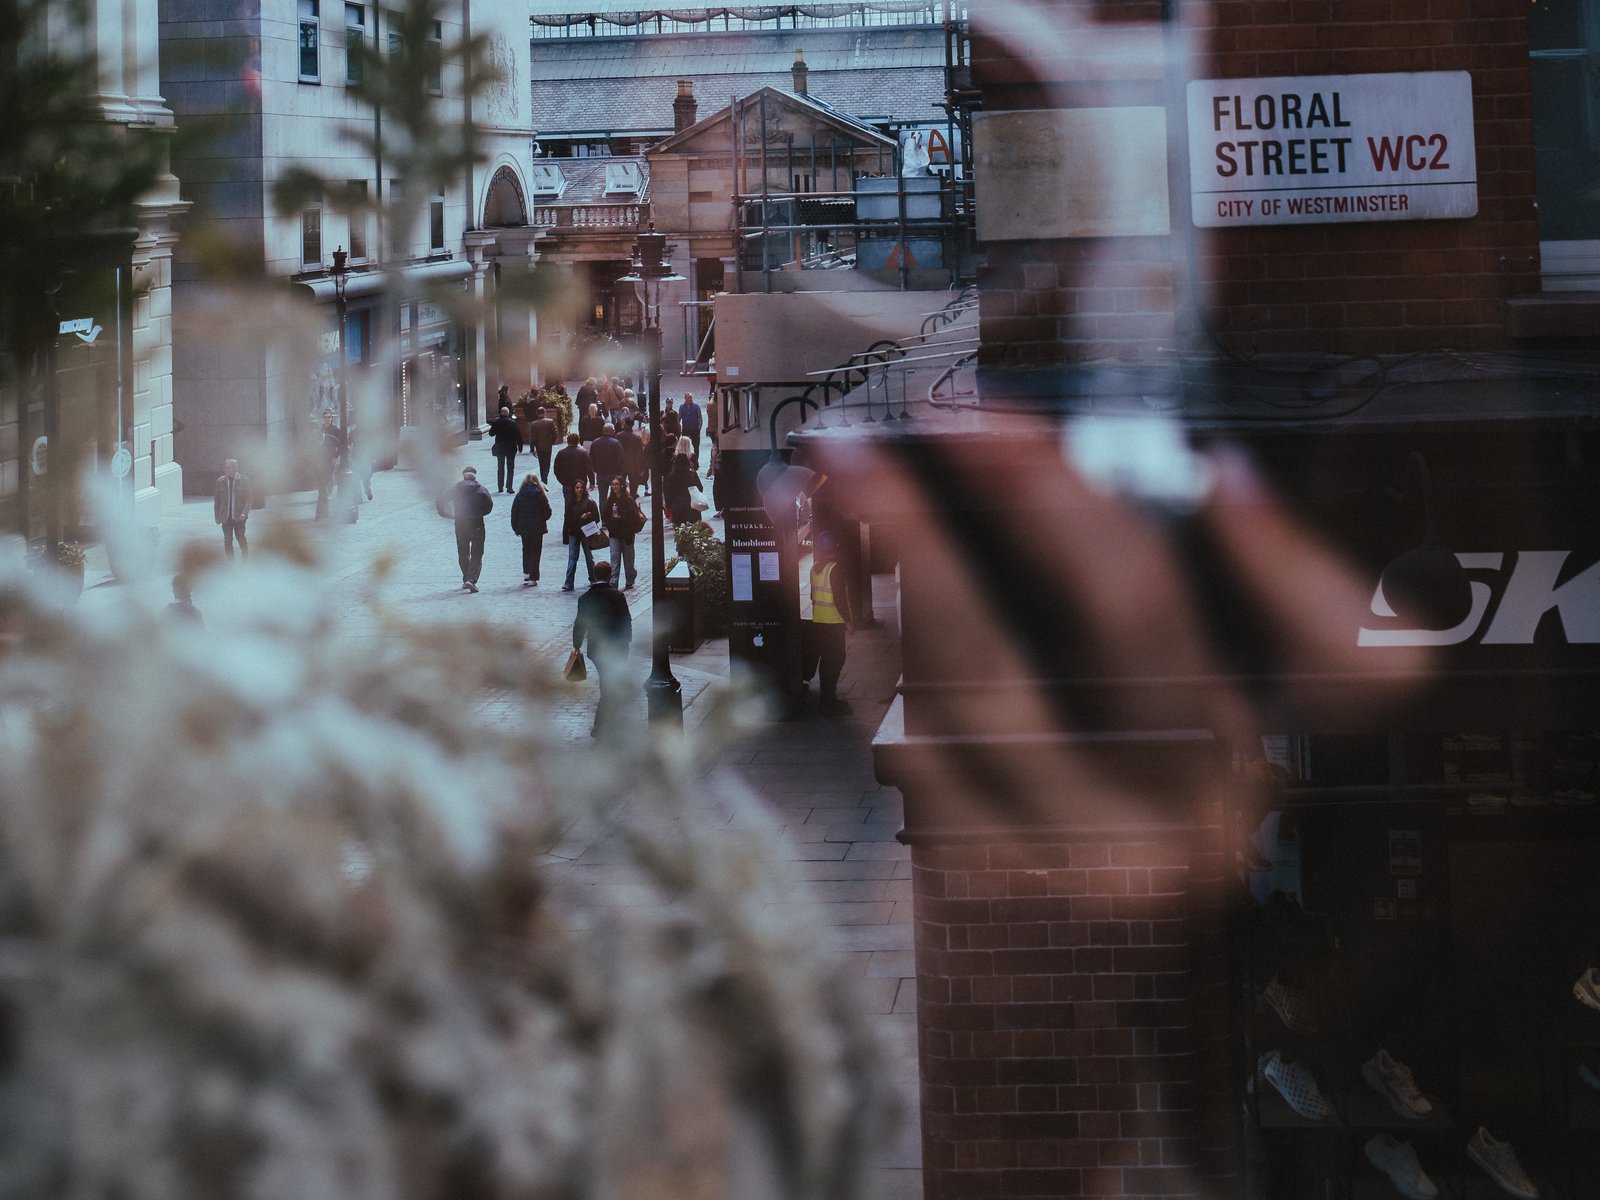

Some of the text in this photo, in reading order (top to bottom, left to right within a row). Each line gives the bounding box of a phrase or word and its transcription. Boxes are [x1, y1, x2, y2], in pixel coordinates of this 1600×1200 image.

[1212, 92, 1351, 132] FLORAL
[1215, 133, 1450, 178] STREET WC2
[1217, 194, 1409, 218] CITY OF WESTMINSTER
[732, 539, 776, 547] bloobloom
